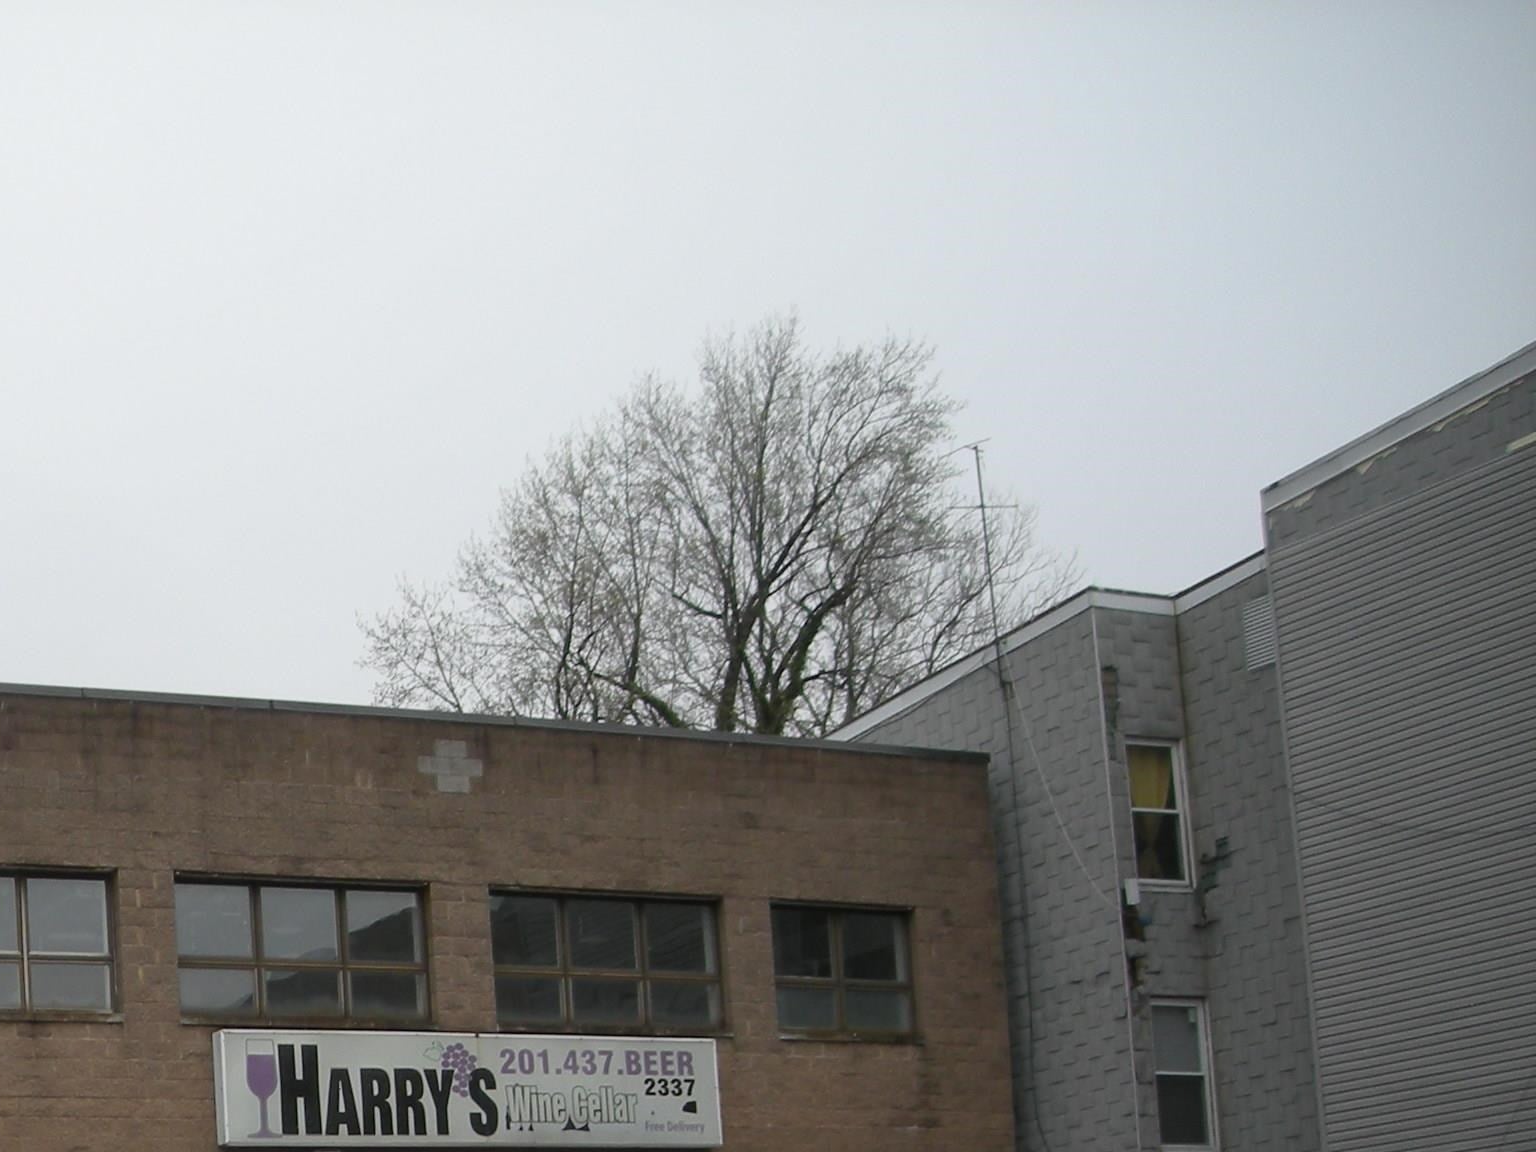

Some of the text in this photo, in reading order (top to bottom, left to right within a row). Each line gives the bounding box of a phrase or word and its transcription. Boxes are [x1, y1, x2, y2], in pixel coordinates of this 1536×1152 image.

[499, 1048, 695, 1077] 201.437.BEER
[644, 1078, 696, 1097] 2337
[505, 1084, 639, 1124] Wine Cellar
